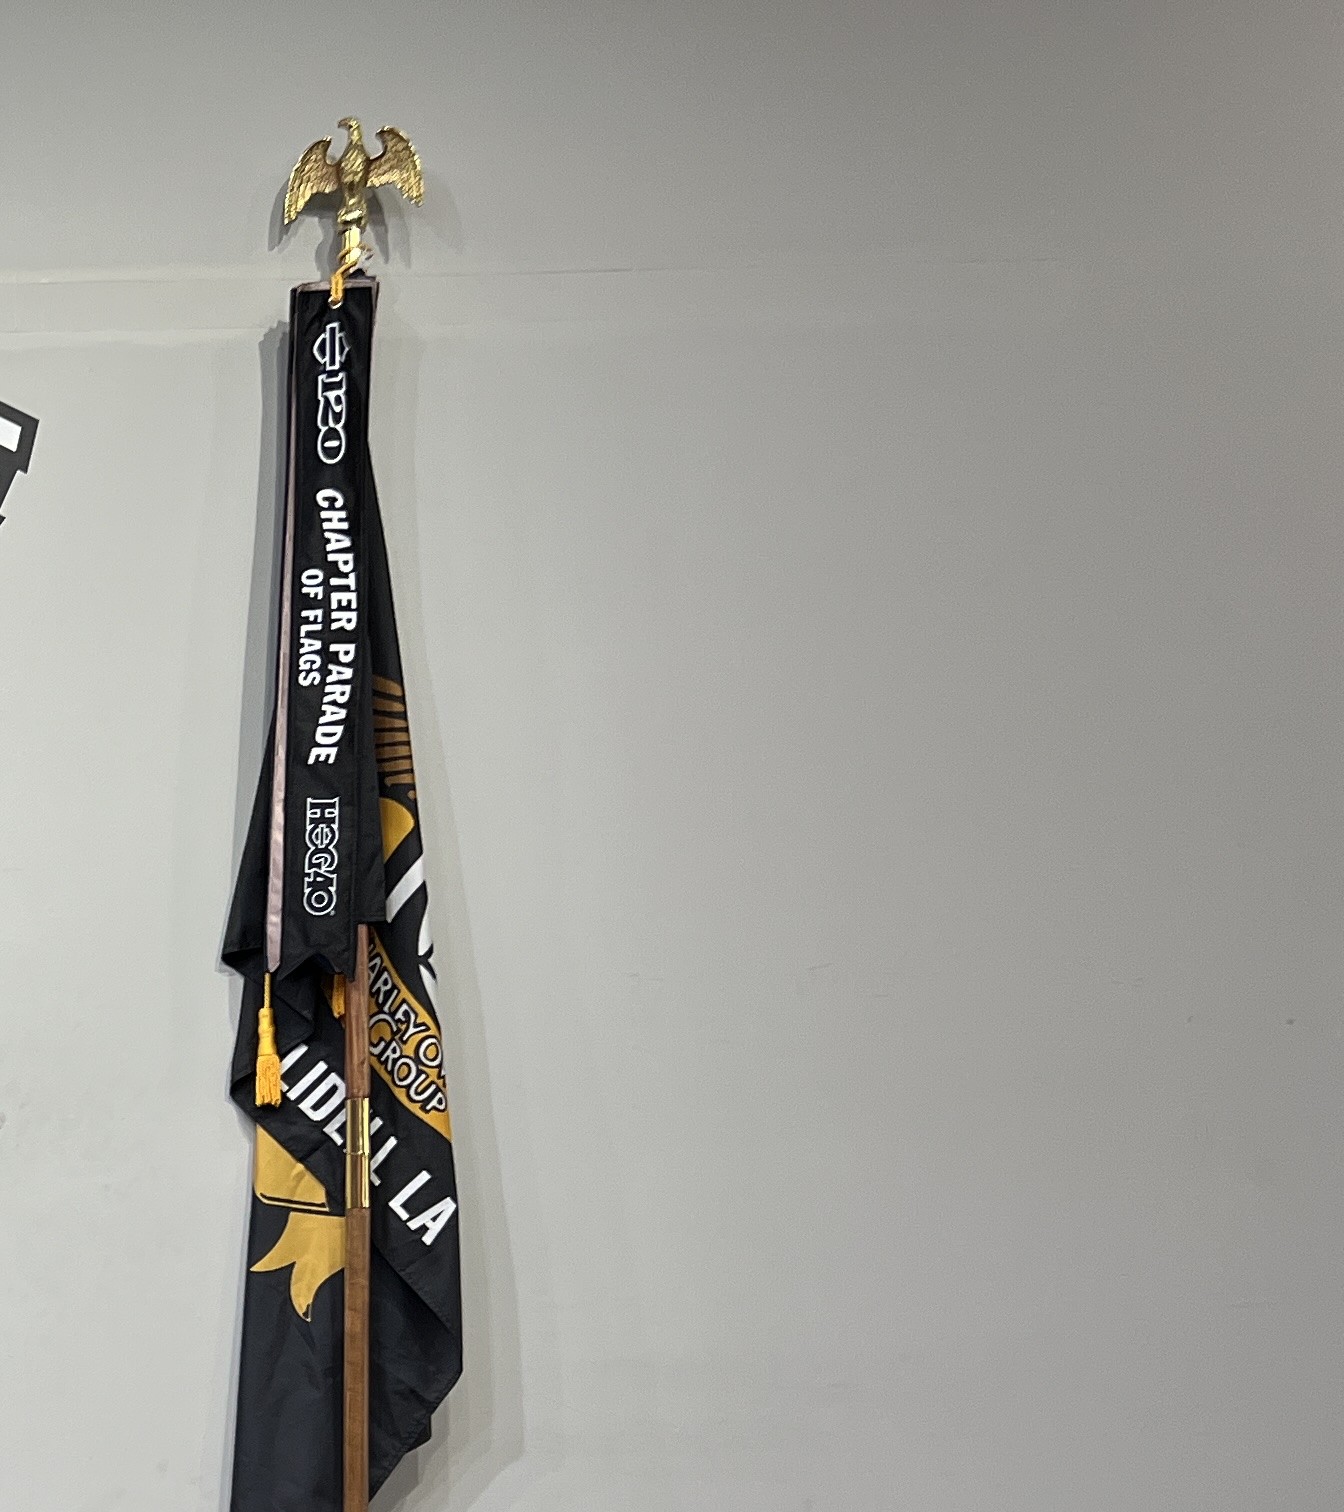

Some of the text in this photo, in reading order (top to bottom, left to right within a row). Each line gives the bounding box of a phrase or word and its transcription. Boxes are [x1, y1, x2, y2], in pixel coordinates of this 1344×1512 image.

[298, 568, 324, 687] OF FLAGS
[307, 488, 358, 765] CHAPTER PARADE
[369, 1013, 447, 1111] GROUP
[388, 1170, 457, 1246] LA
